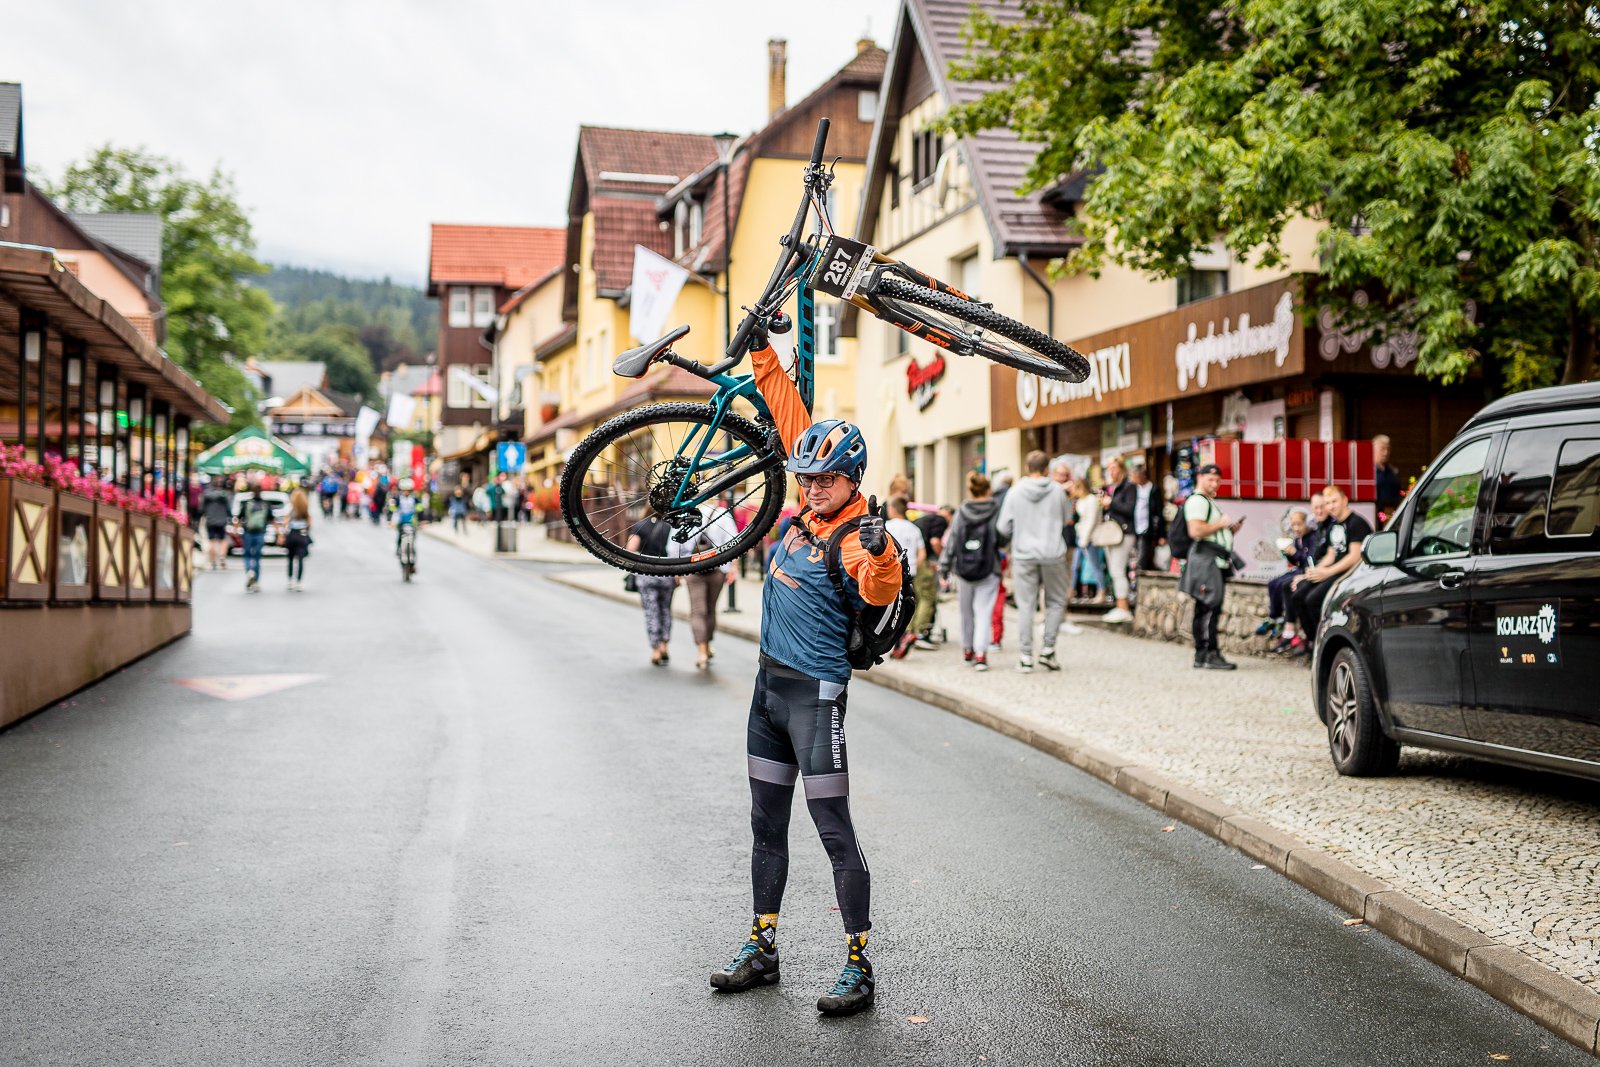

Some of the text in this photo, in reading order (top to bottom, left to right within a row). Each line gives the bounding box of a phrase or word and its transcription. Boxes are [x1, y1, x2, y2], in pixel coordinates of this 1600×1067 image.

[823, 247, 852, 286] 287
[891, 586, 903, 630] SCOT
[1496, 615, 1537, 636] KOLARZ
[831, 706, 842, 769] ROWEROWY BYTOM
